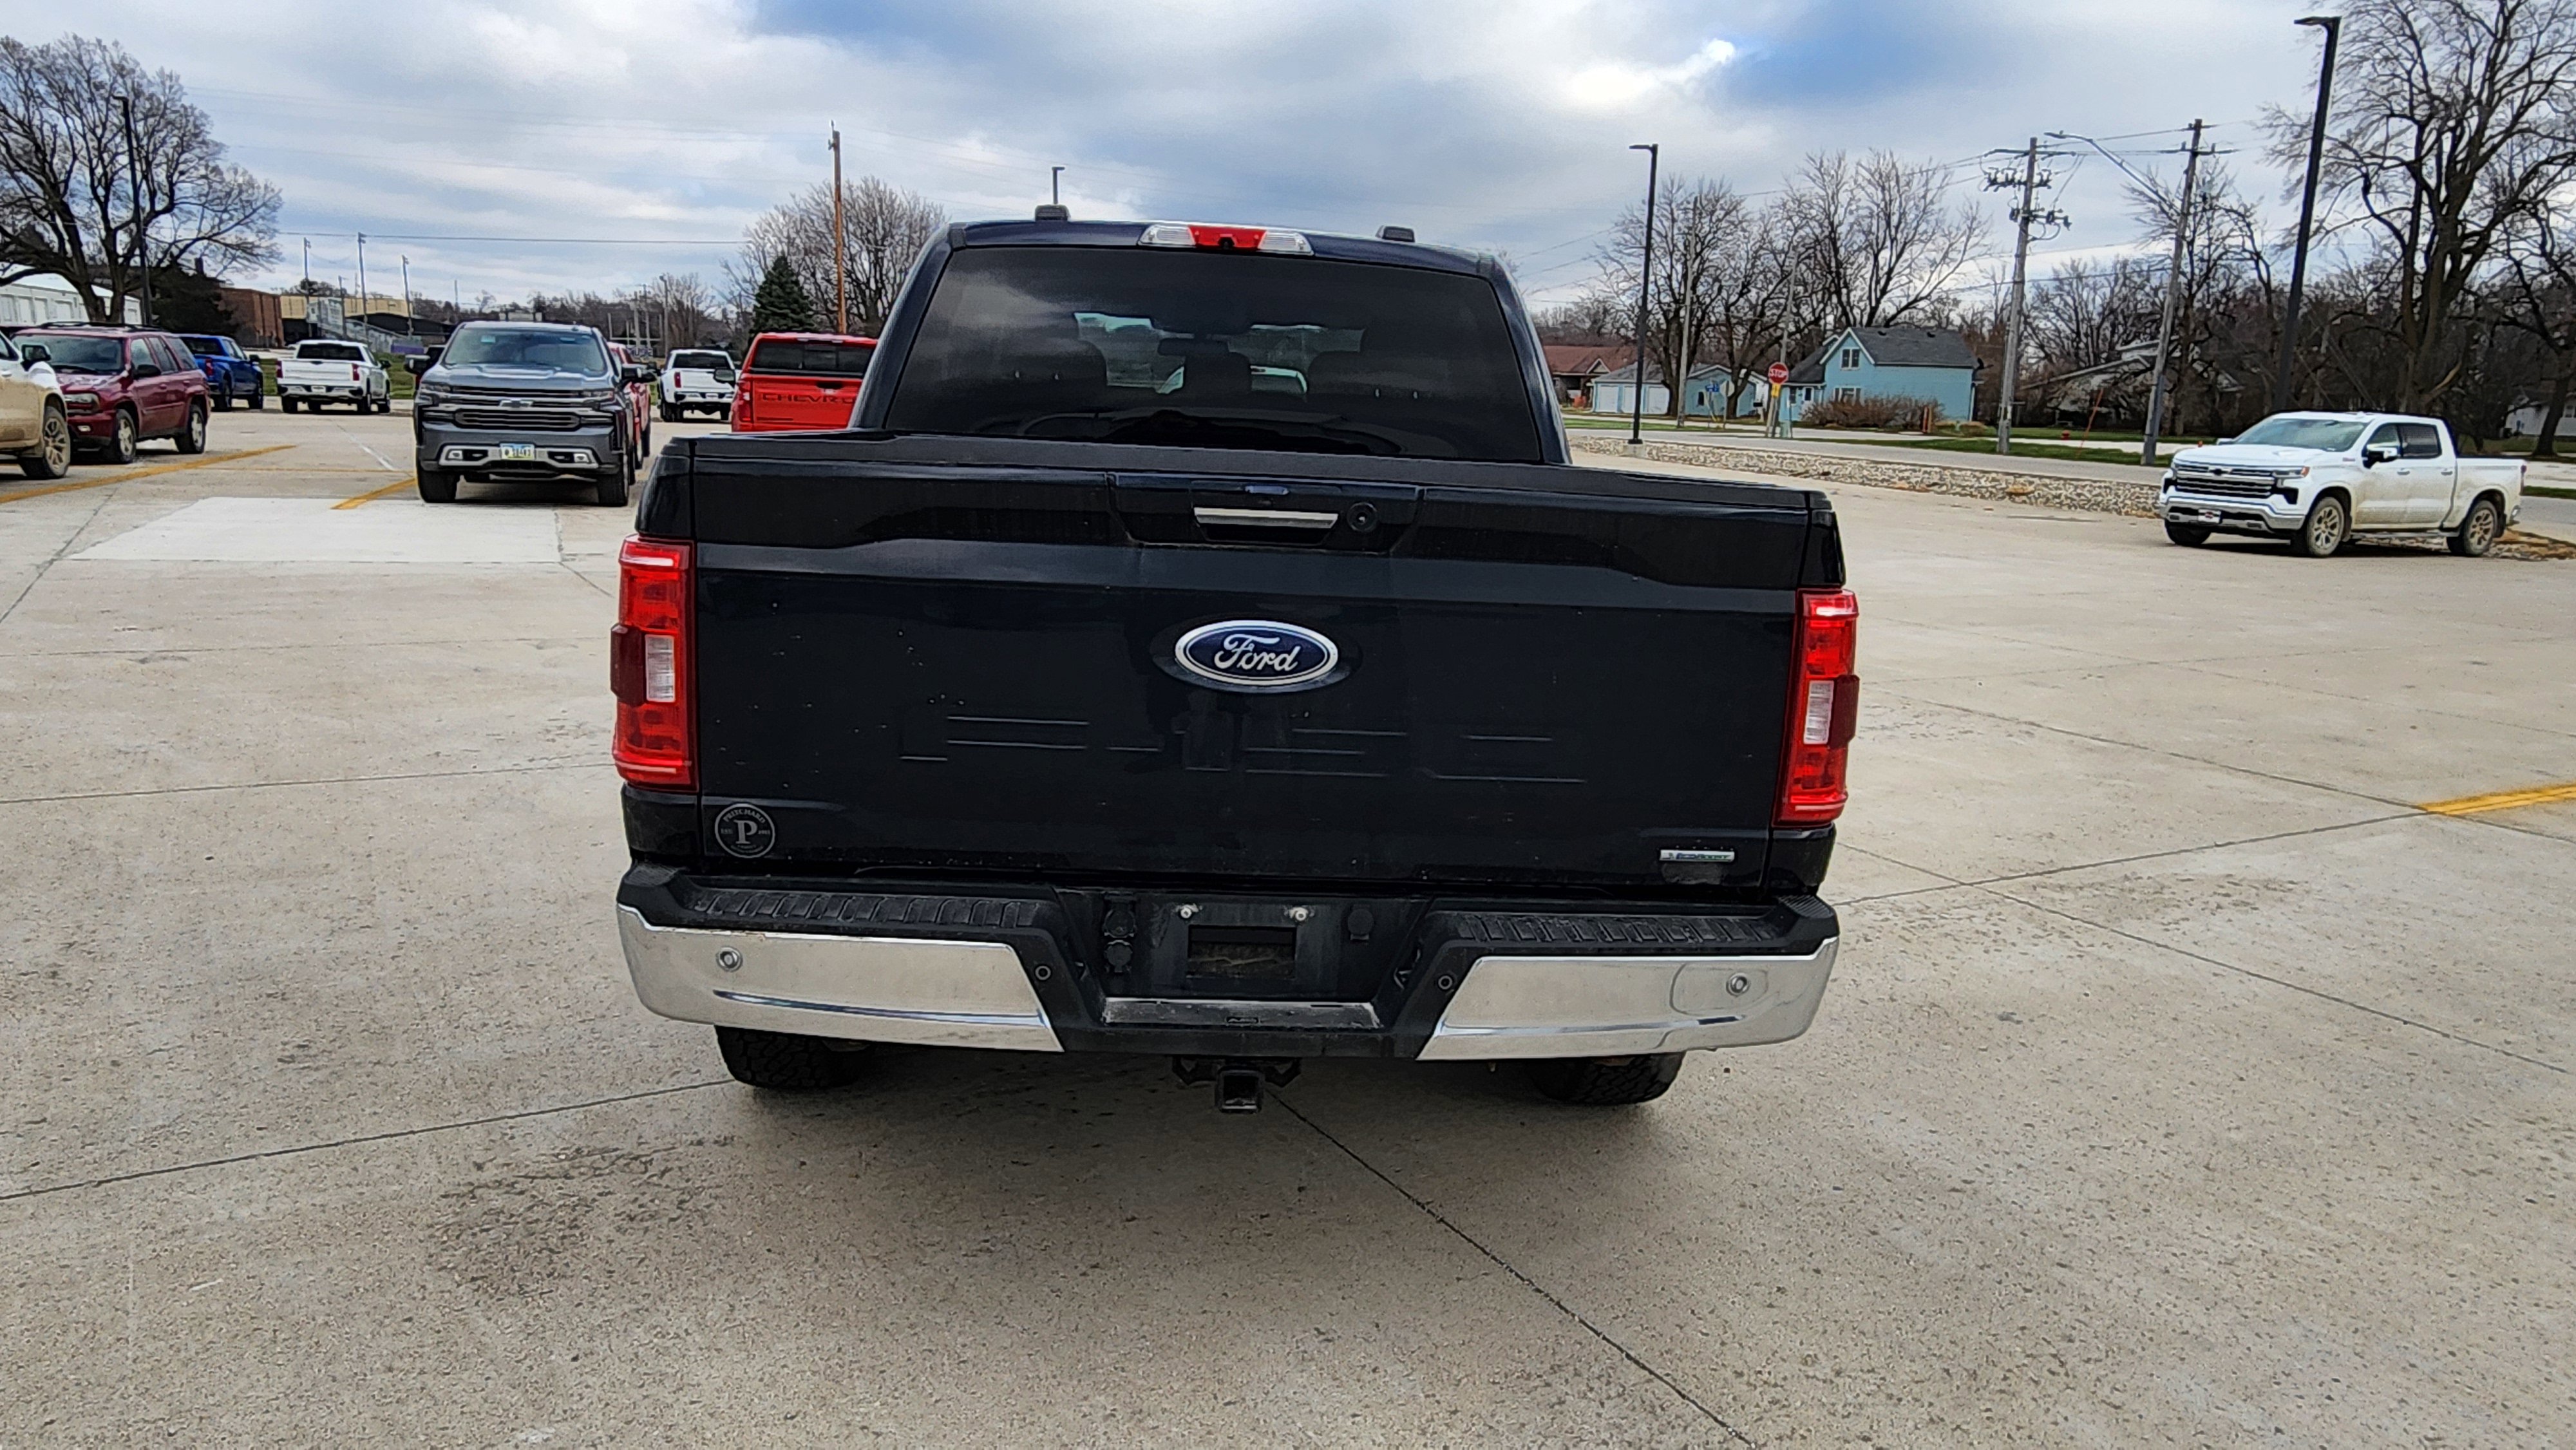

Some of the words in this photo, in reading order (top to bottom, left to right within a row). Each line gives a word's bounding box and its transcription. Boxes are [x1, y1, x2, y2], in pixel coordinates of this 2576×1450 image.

[1214, 634, 1301, 672] Ford
[723, 809, 766, 823] PRITCHARD
[734, 820, 757, 844] P
